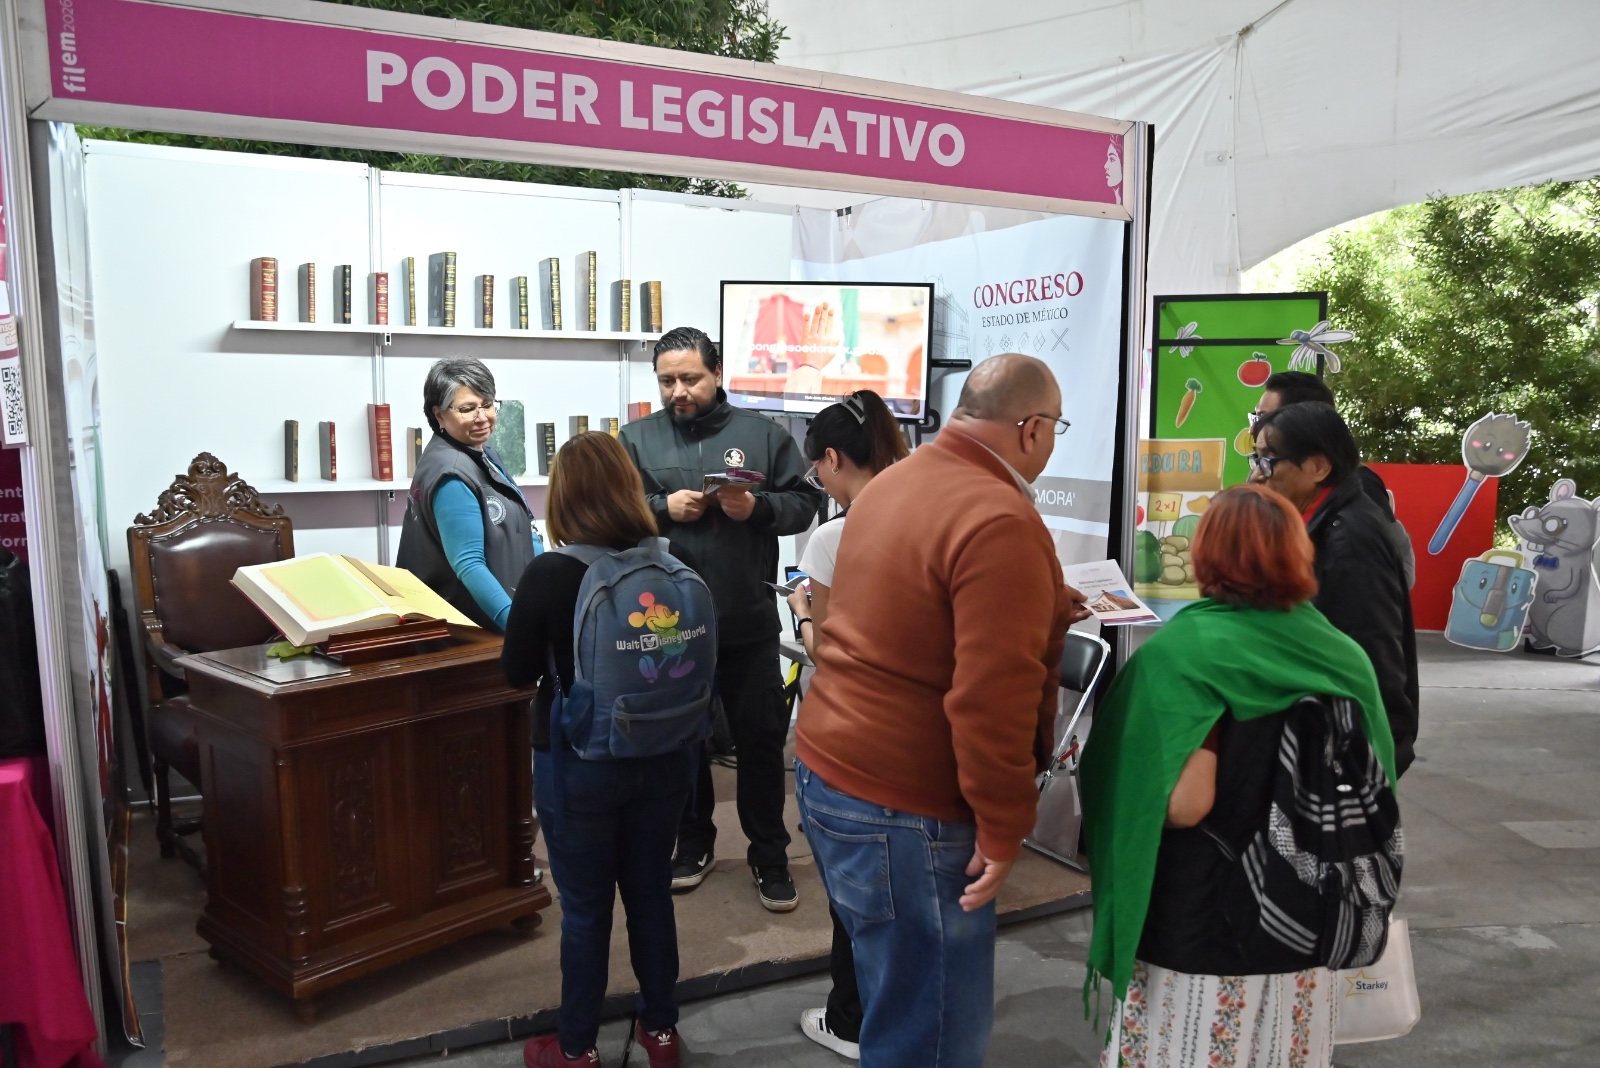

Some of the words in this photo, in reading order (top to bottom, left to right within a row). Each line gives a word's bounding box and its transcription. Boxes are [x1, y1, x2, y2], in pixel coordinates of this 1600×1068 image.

[366, 50, 600, 125] PODER
[619, 80, 966, 168] LEGISLATIVO
[974, 272, 1083, 308] CONGRESO
[982, 313, 1014, 328] ESTADO
[1015, 312, 1031, 325] DE
[1032, 307, 1069, 323] MÉXICO
[616, 640, 640, 650] Walt
[681, 625, 706, 640] World
[1356, 981, 1388, 990] Starkey
